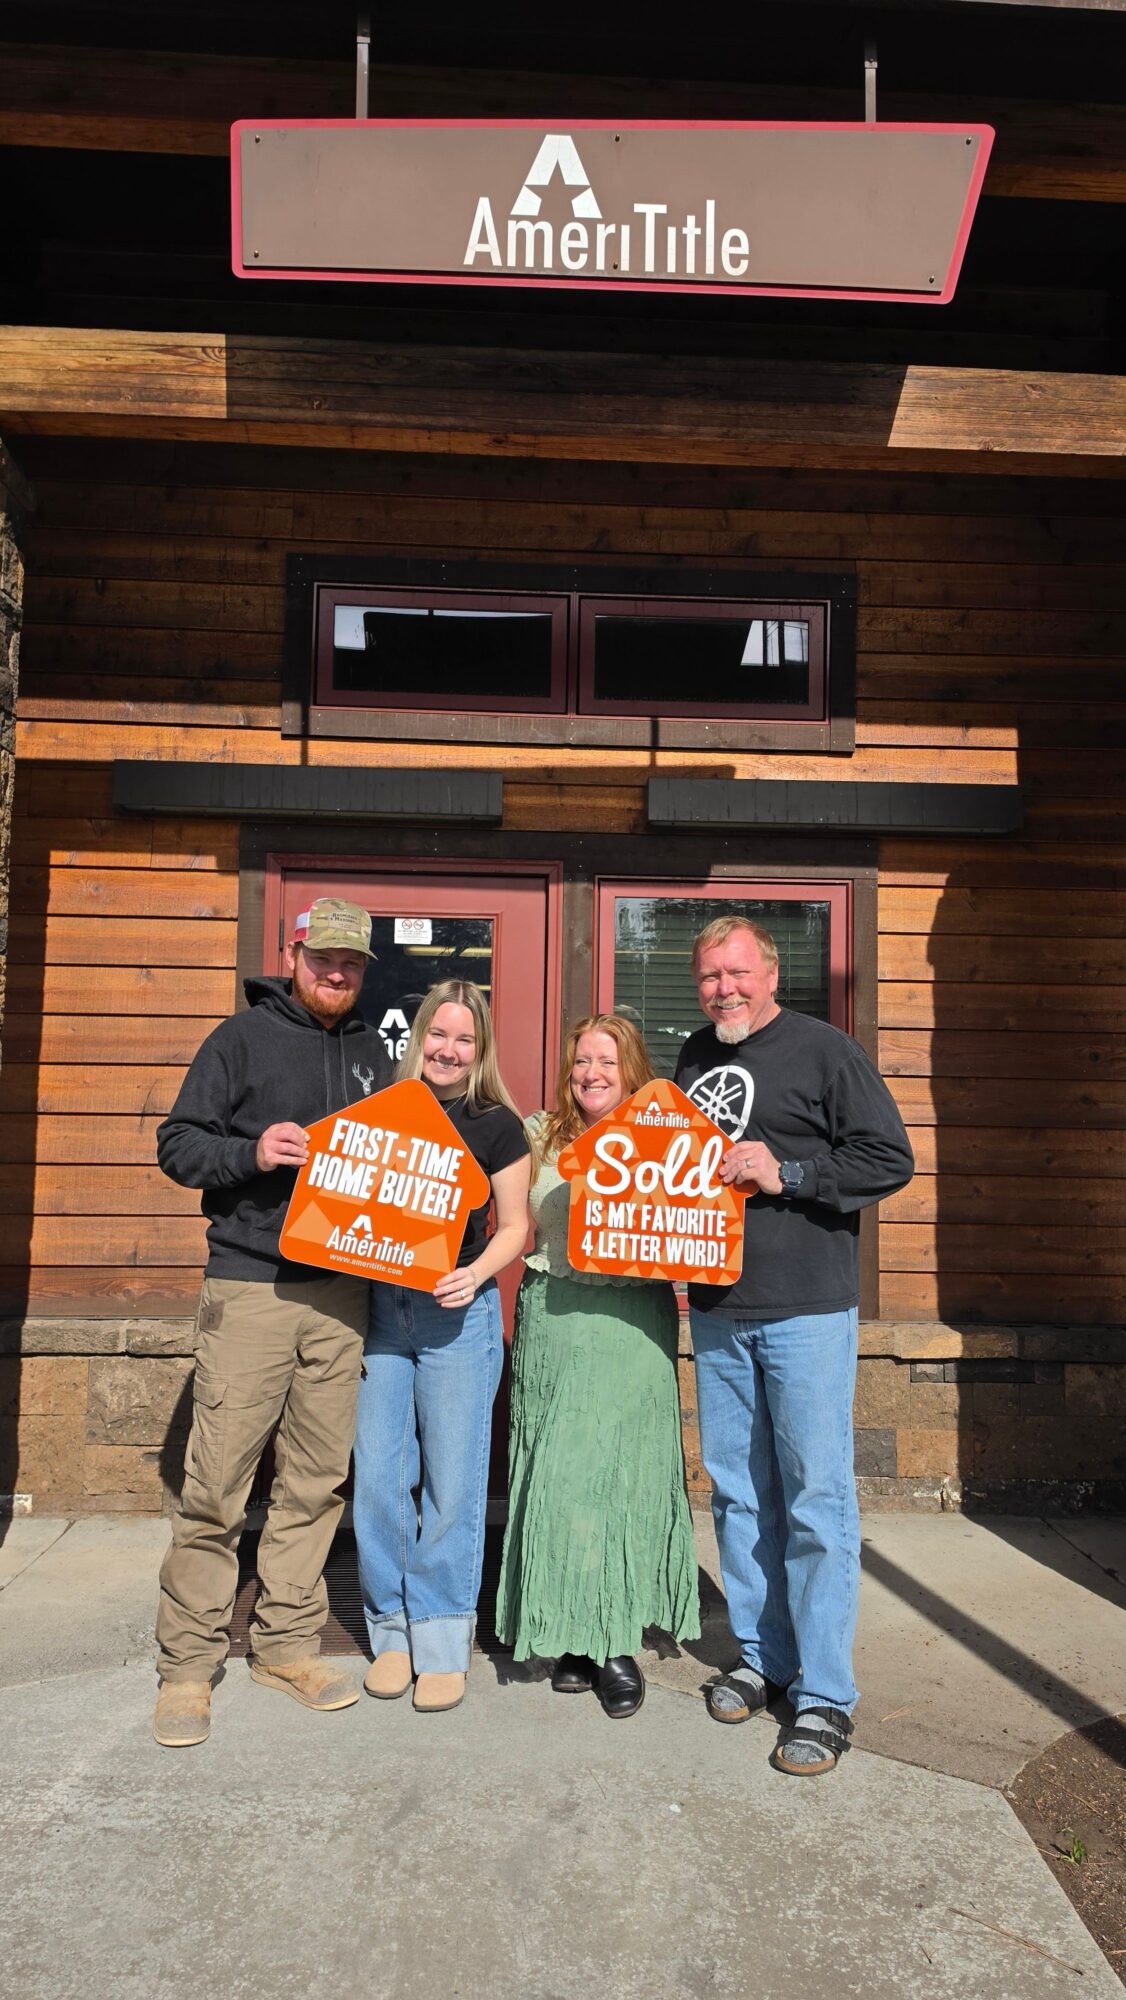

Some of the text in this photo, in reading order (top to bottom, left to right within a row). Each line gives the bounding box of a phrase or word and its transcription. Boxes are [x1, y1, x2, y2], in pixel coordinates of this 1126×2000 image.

[464, 197, 750, 276] AmeriTitle
[635, 1111, 689, 1128] AmeriTitle
[586, 1133, 723, 1198] Sold
[308, 1152, 462, 1220] HOME BUYER!
[585, 1199, 727, 1237] IS MY FAVORITE
[326, 1225, 415, 1267] AmeriTitle
[329, 1253, 403, 1276] www.amerititle.com
[581, 1230, 726, 1268] 4 LETTER WORD!
